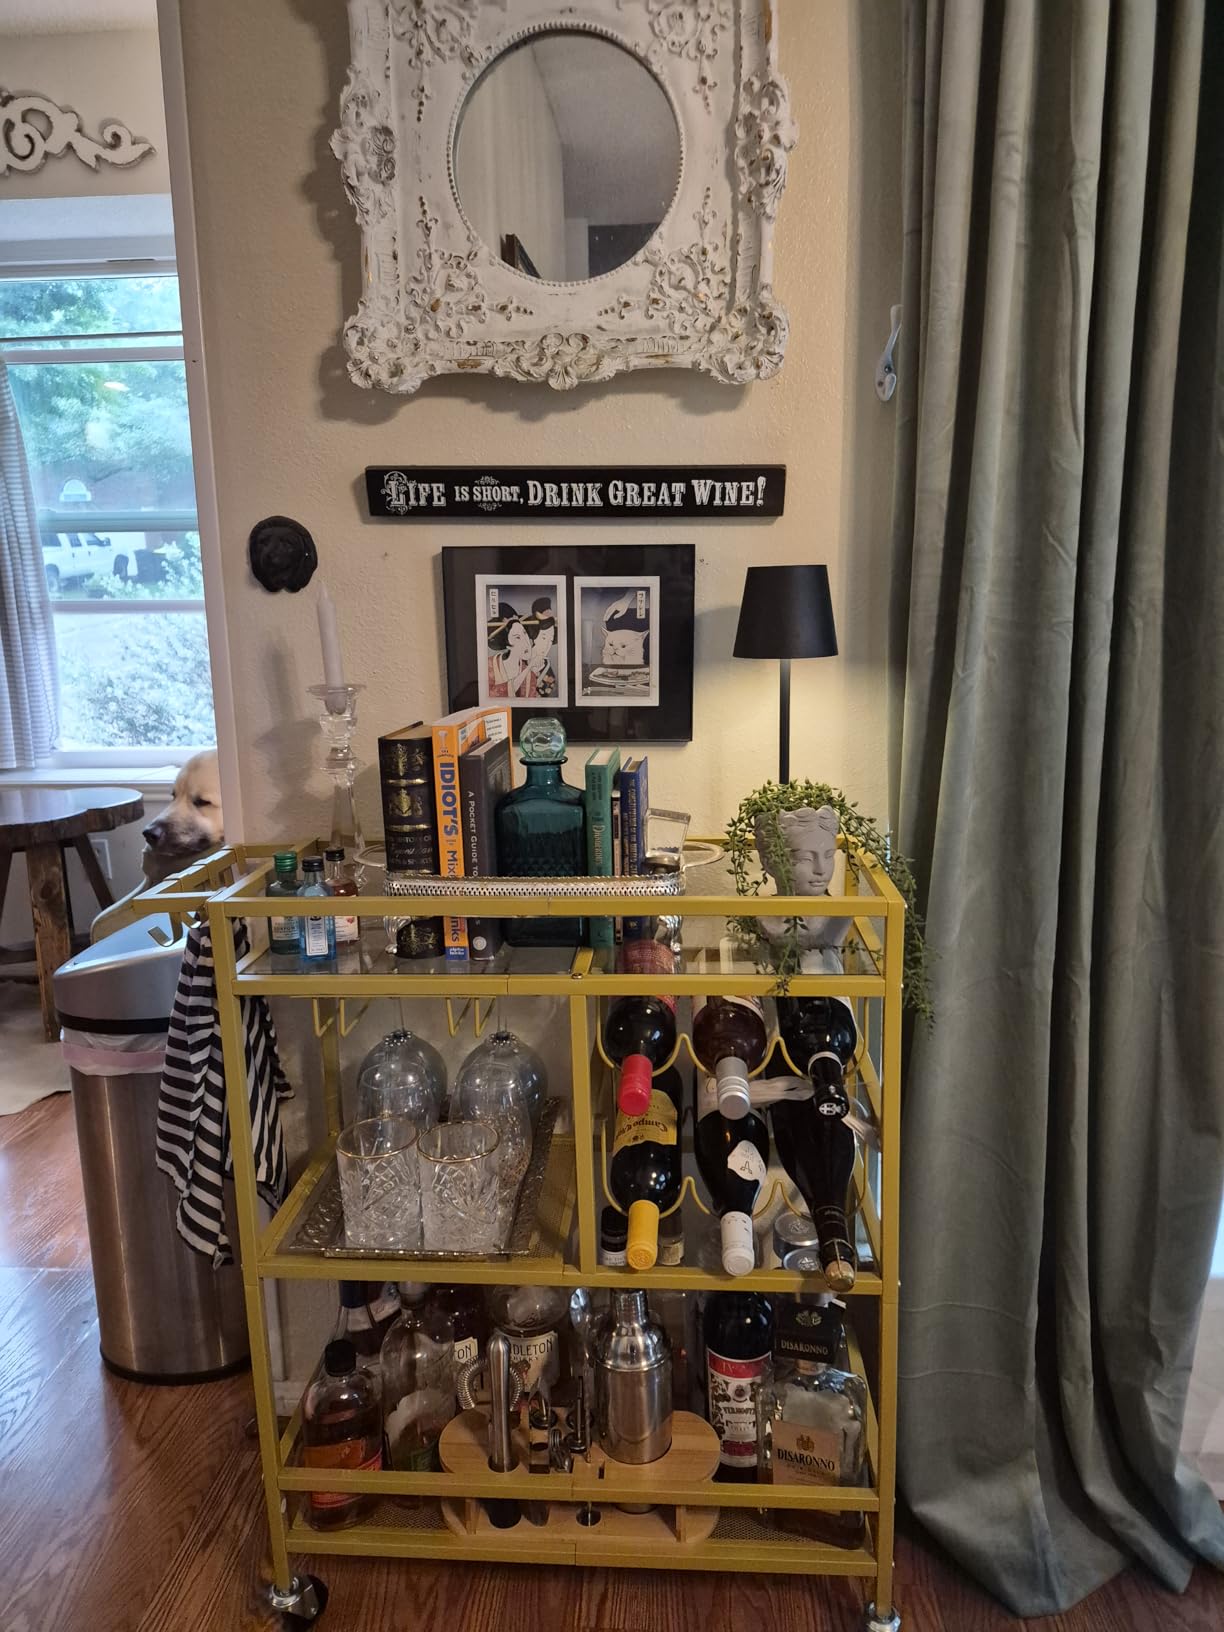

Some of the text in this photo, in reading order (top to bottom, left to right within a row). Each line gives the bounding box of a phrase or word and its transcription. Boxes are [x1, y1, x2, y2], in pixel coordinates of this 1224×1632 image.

[381, 471, 767, 515] LIFE IS SHORT, DRINK GREAT WINE!
[440, 762, 459, 837] IDIOT'S
[468, 800, 477, 833] POCKET
[470, 835, 478, 863] GUIDE
[447, 850, 458, 877] Mix
[472, 865, 479, 877] TO
[451, 917, 462, 943] inks
[510, 1337, 553, 1357] DLETON
[780, 1339, 829, 1356] DISARONNO
[777, 1447, 835, 1472] DISARONNO
